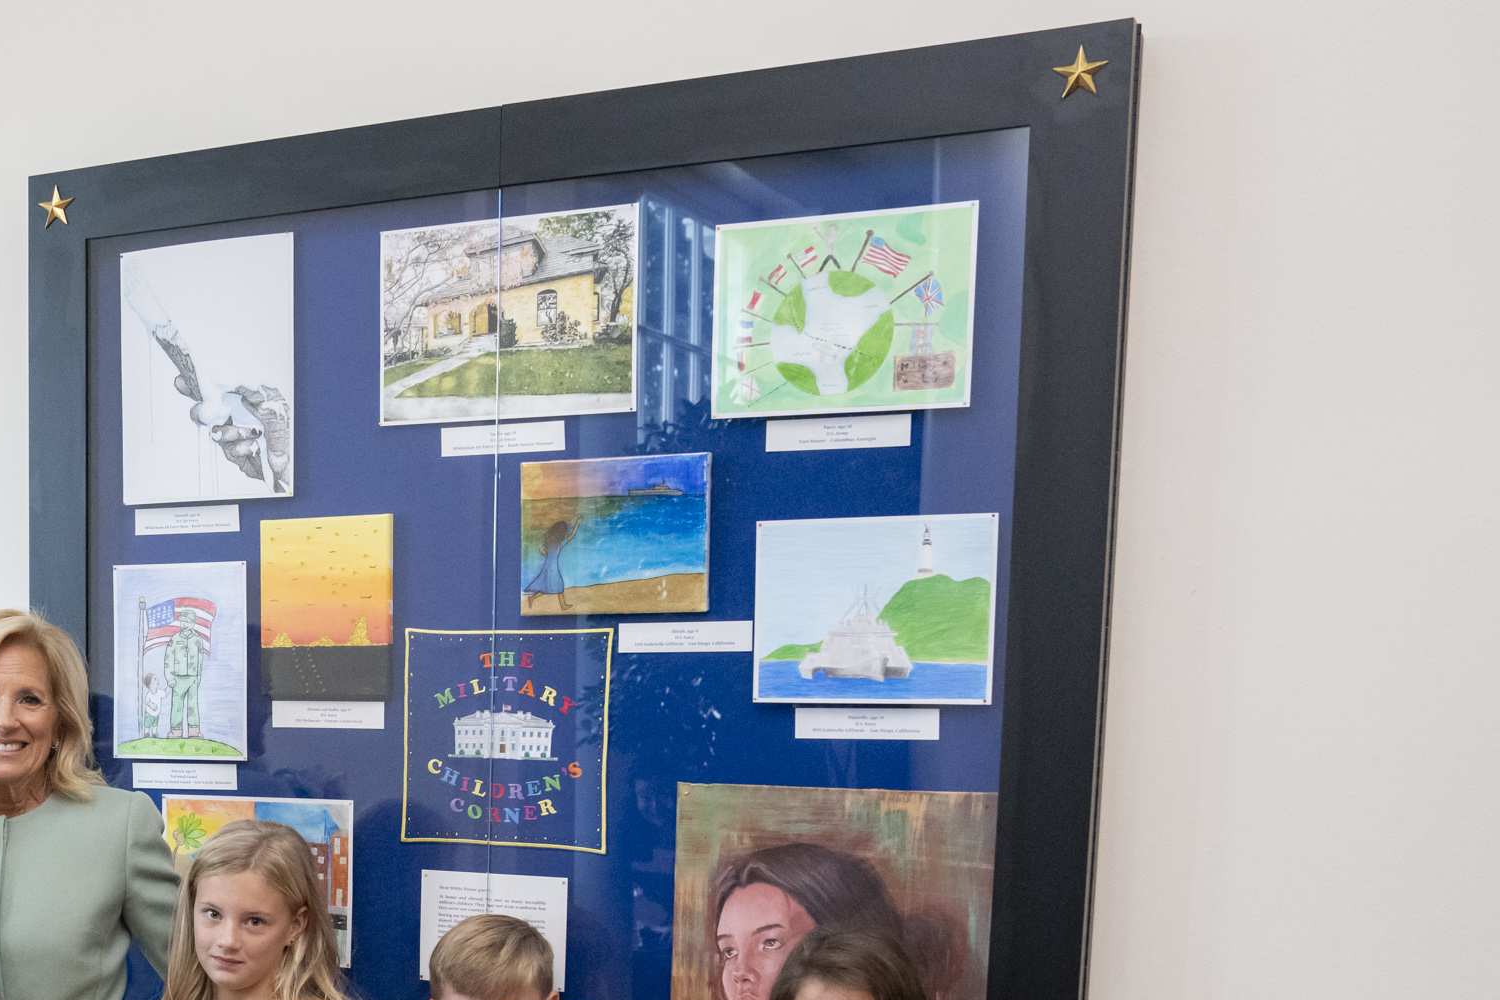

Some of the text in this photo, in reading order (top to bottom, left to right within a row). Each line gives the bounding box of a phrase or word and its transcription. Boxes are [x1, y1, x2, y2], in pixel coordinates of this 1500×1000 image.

[480, 652, 534, 669] THE
[434, 676, 577, 714] MILITARY
[427, 758, 583, 800] CHILDREN'S
[450, 798, 557, 824] CORNER
